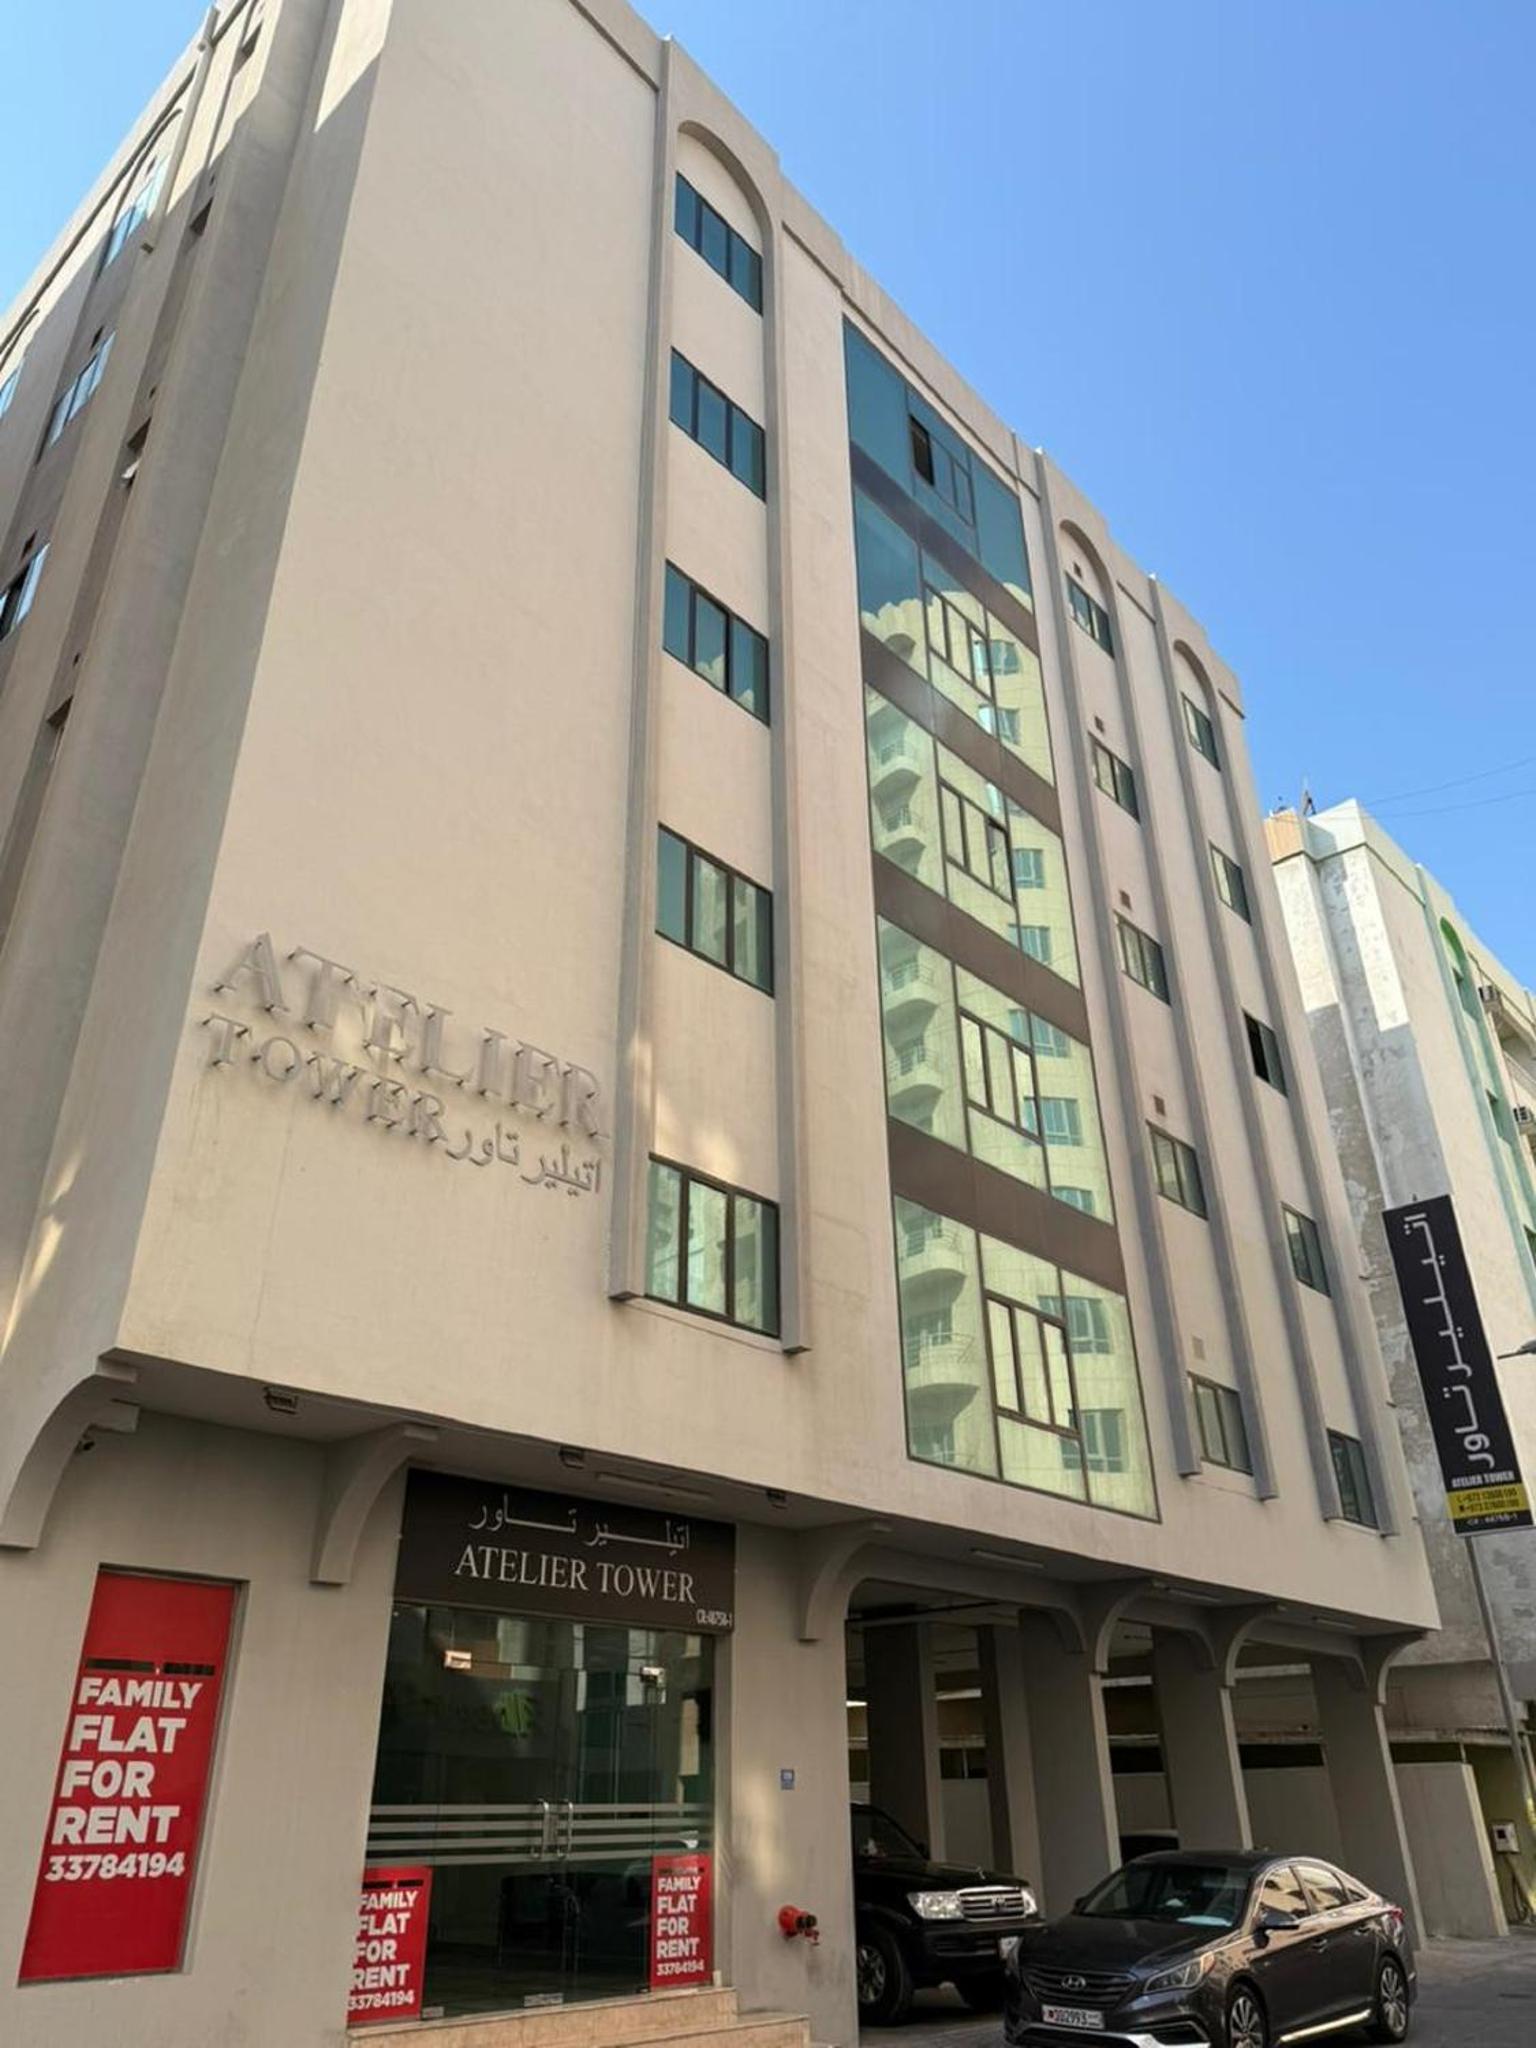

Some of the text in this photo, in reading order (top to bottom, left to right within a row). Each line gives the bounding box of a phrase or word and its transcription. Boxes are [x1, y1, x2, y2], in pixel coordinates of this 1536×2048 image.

[213, 931, 611, 1139] ATELIER
[201, 1013, 449, 1143] TOWER
[445, 1122, 520, 1167] تاور
[454, 1543, 696, 1604] ATELIER TOWER
[77, 1677, 203, 1709] FAMILY
[69, 1714, 186, 1754] FLAT
[59, 1759, 155, 1798] FOR
[51, 1805, 180, 1845] RENT
[44, 1852, 185, 1882] 33784194
[656, 1876, 701, 1893] FAMILY
[656, 1894, 698, 1915] FLAT
[656, 1916, 689, 1937] FOR
[656, 1937, 700, 1960] RENT
[350, 1963, 411, 1991] RENT
